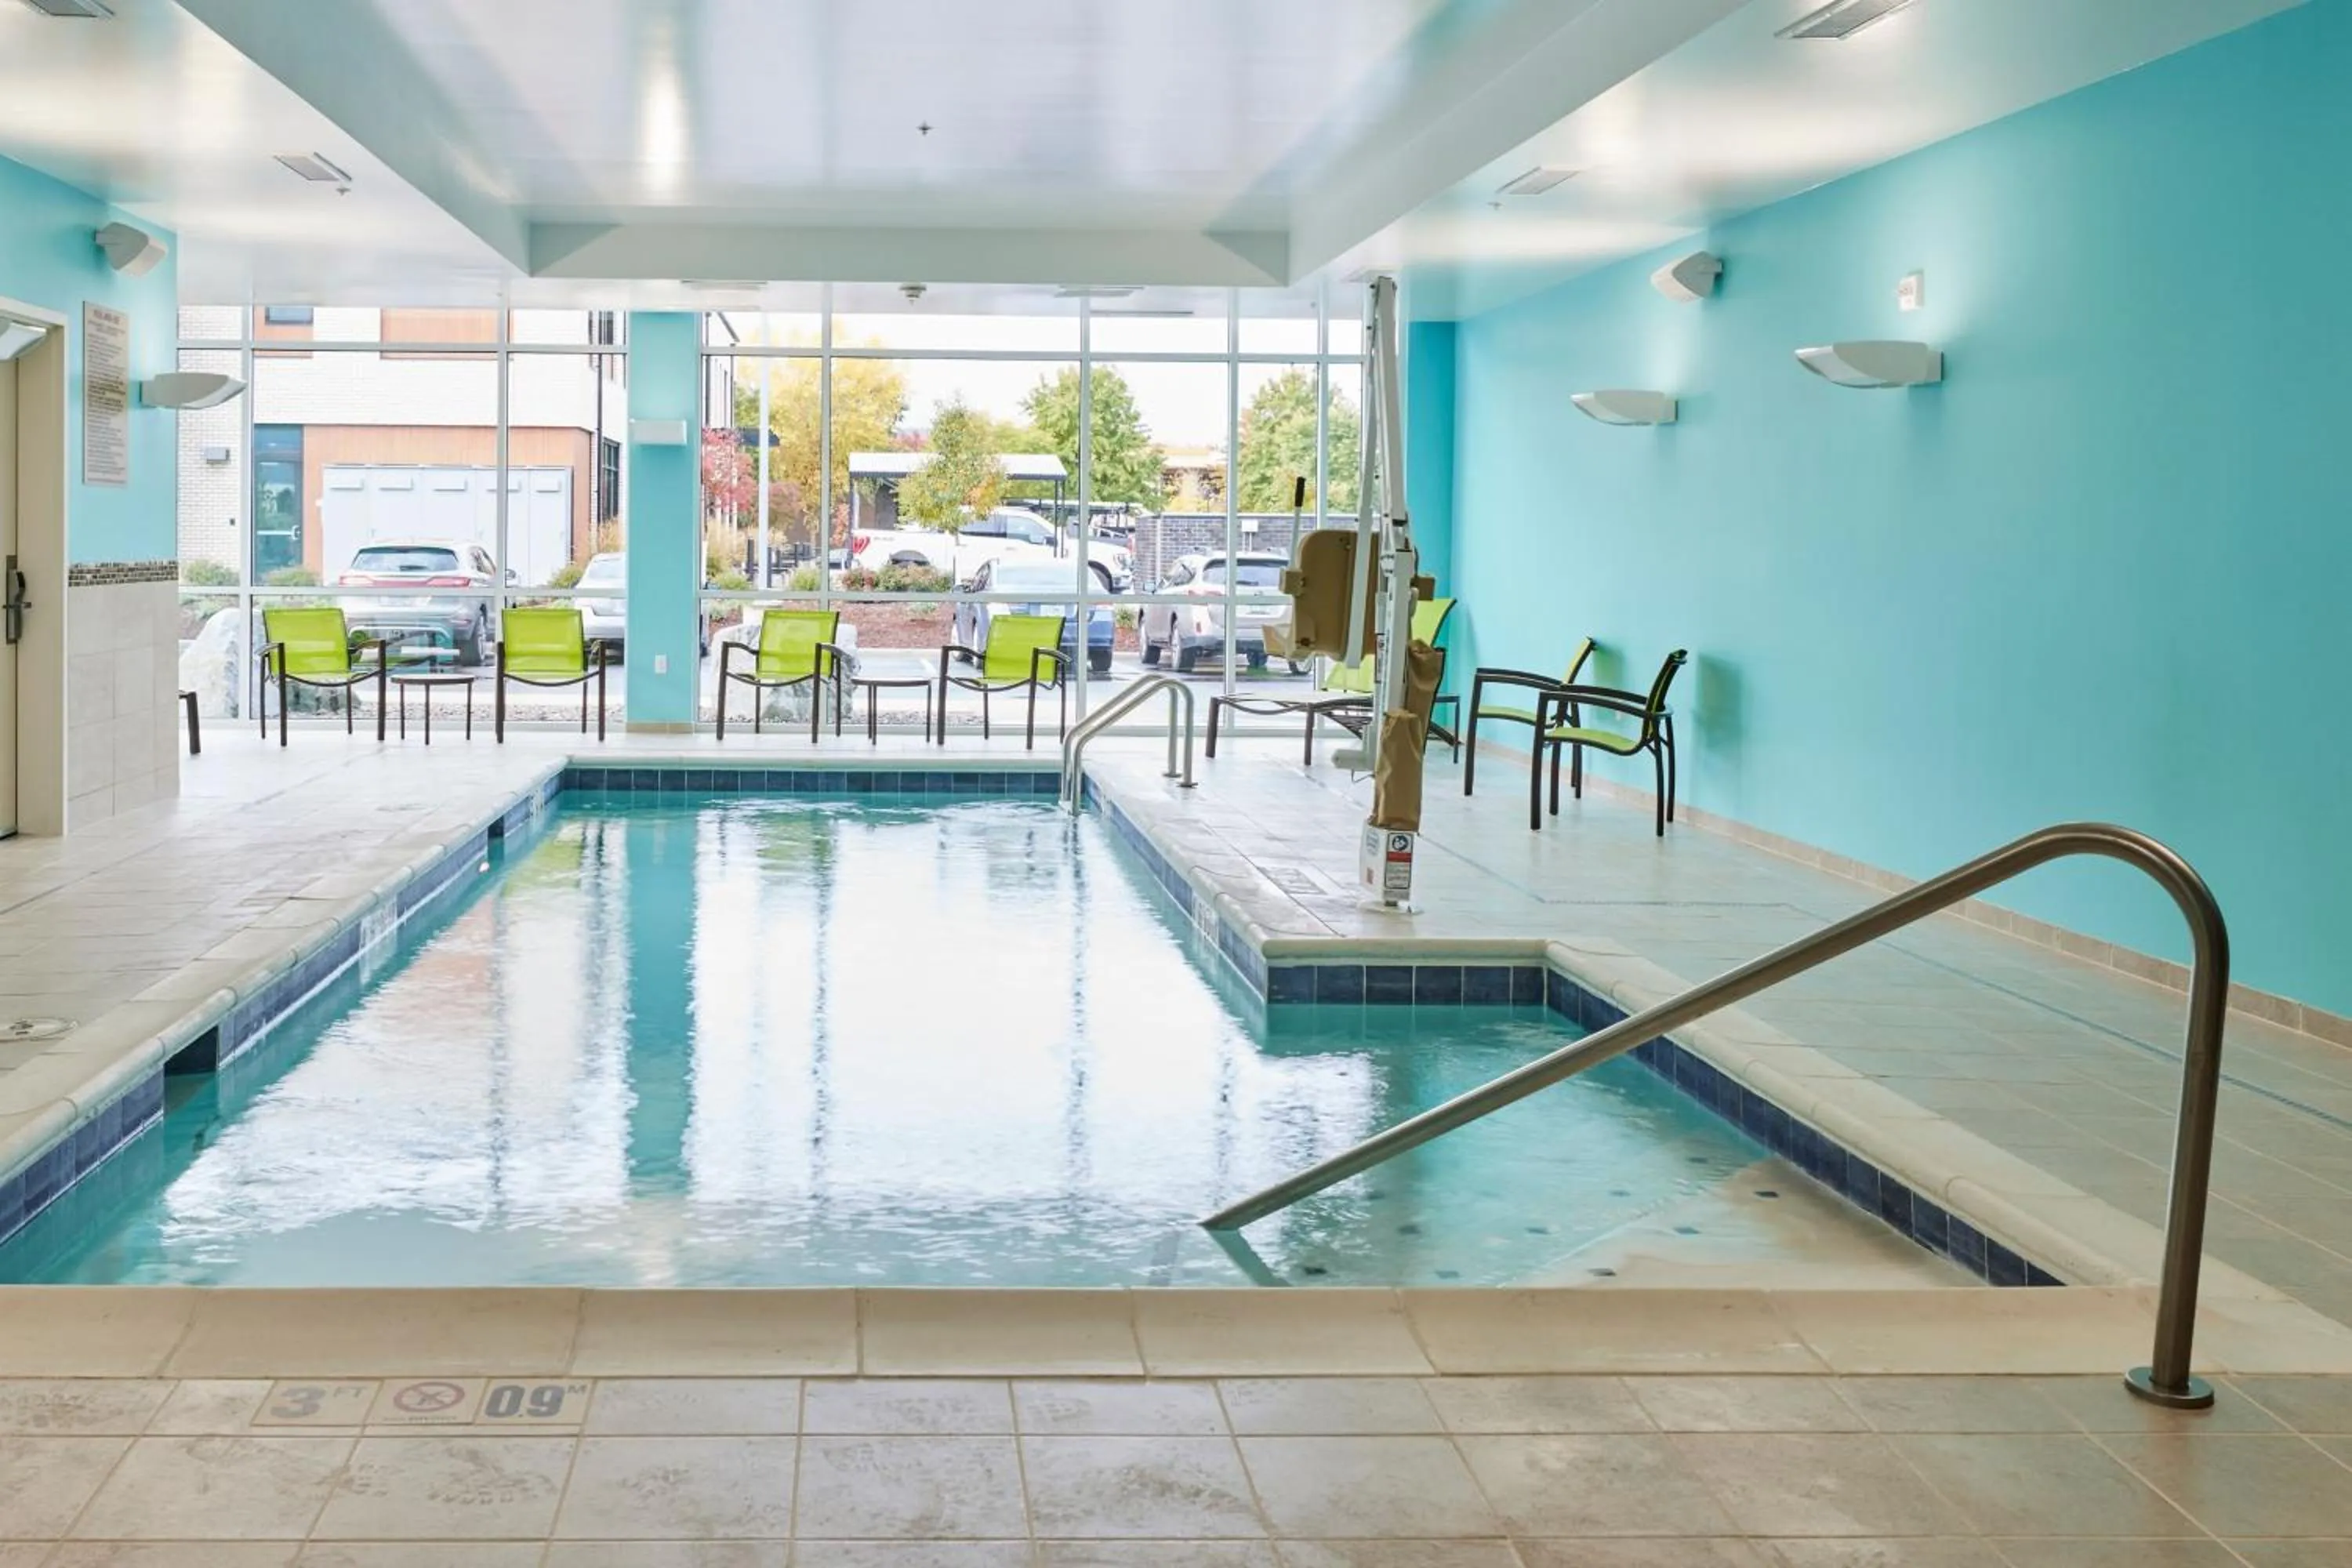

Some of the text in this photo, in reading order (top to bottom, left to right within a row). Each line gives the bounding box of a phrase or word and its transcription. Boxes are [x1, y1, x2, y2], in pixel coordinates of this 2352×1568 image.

[567, 1384, 587, 1394] M
[270, 1386, 367, 1418] 3 FT
